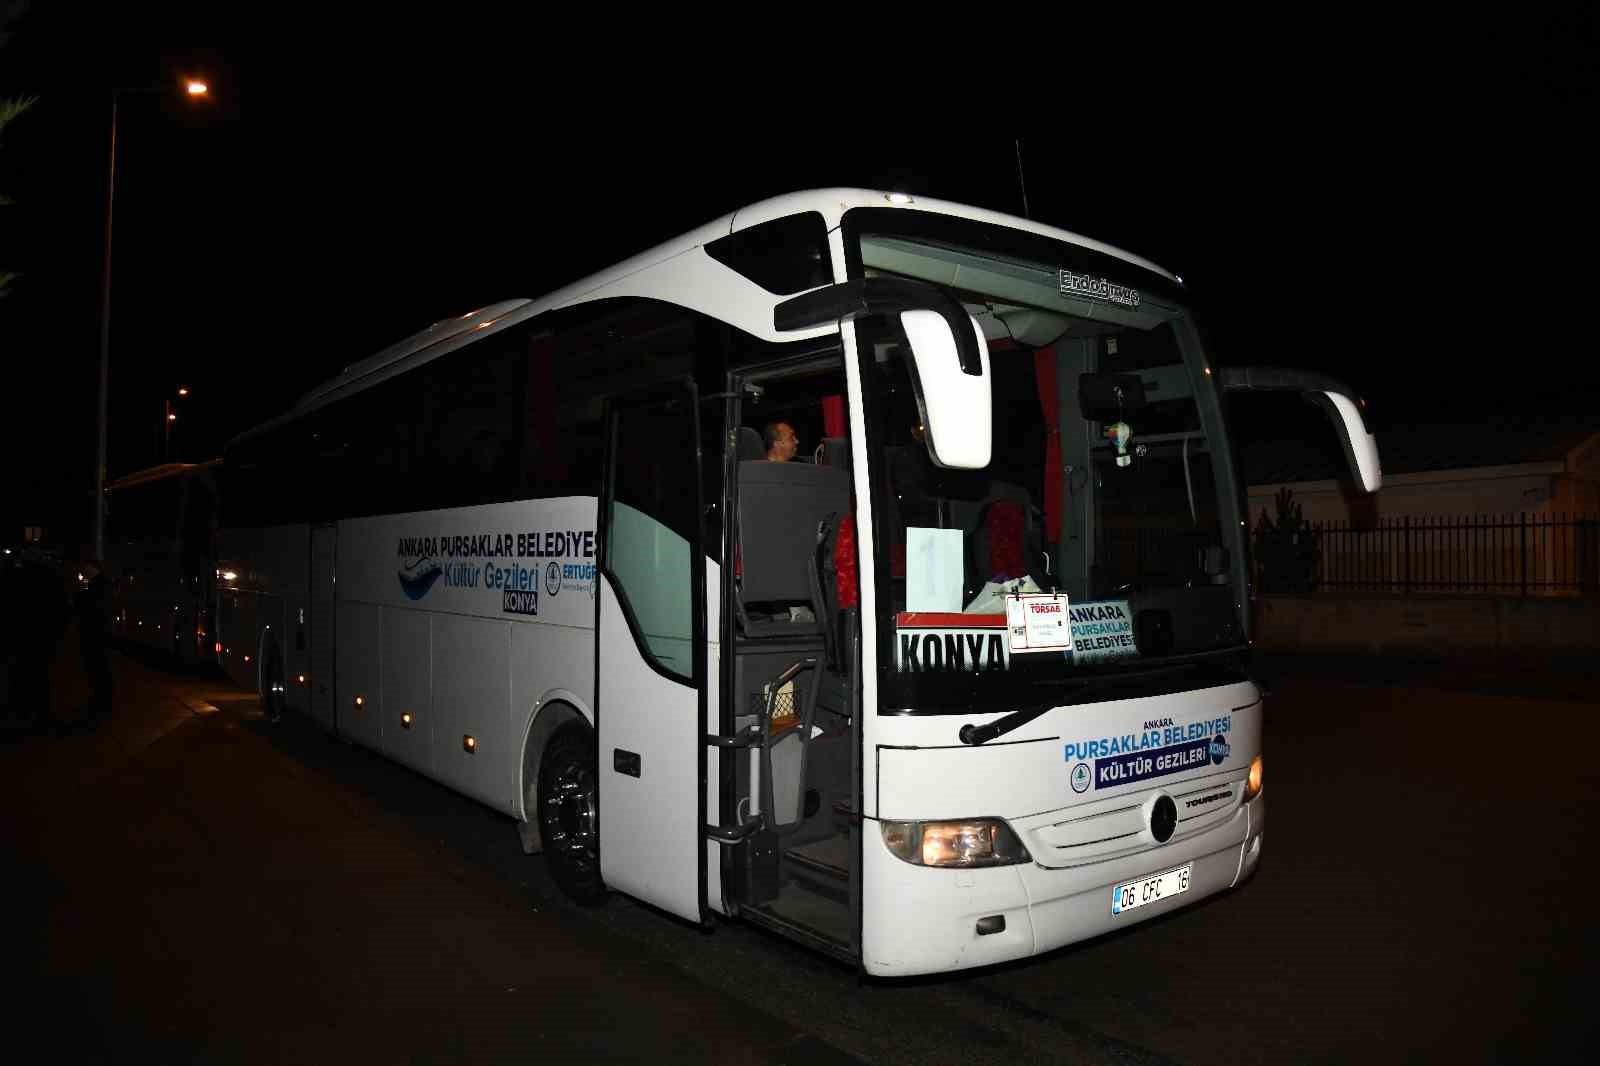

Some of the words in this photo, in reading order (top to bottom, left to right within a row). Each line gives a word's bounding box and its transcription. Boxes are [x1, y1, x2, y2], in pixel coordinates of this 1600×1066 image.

[398, 537, 438, 557] ANKARA
[440, 534, 513, 557] PURSAKLAR
[517, 531, 598, 557] BELEDİYE
[444, 562, 480, 588] Kültür
[484, 562, 539, 590] Gezileri
[504, 592, 537, 611] KONYA
[1069, 605, 1125, 622] ANKARA
[1071, 622, 1130, 637] PURSAKLAR
[901, 634, 1005, 672] KONYA
[1143, 718, 1174, 730] ANKARA
[1064, 730, 1161, 762] PURSAKLAR
[1164, 716, 1231, 745] BELEDİYESİ
[1100, 757, 1153, 783] KÜLTÜR
[1156, 746, 1206, 771] GEZİLERİ
[1121, 887, 1136, 908] 06
[1142, 879, 1162, 902] CFC
